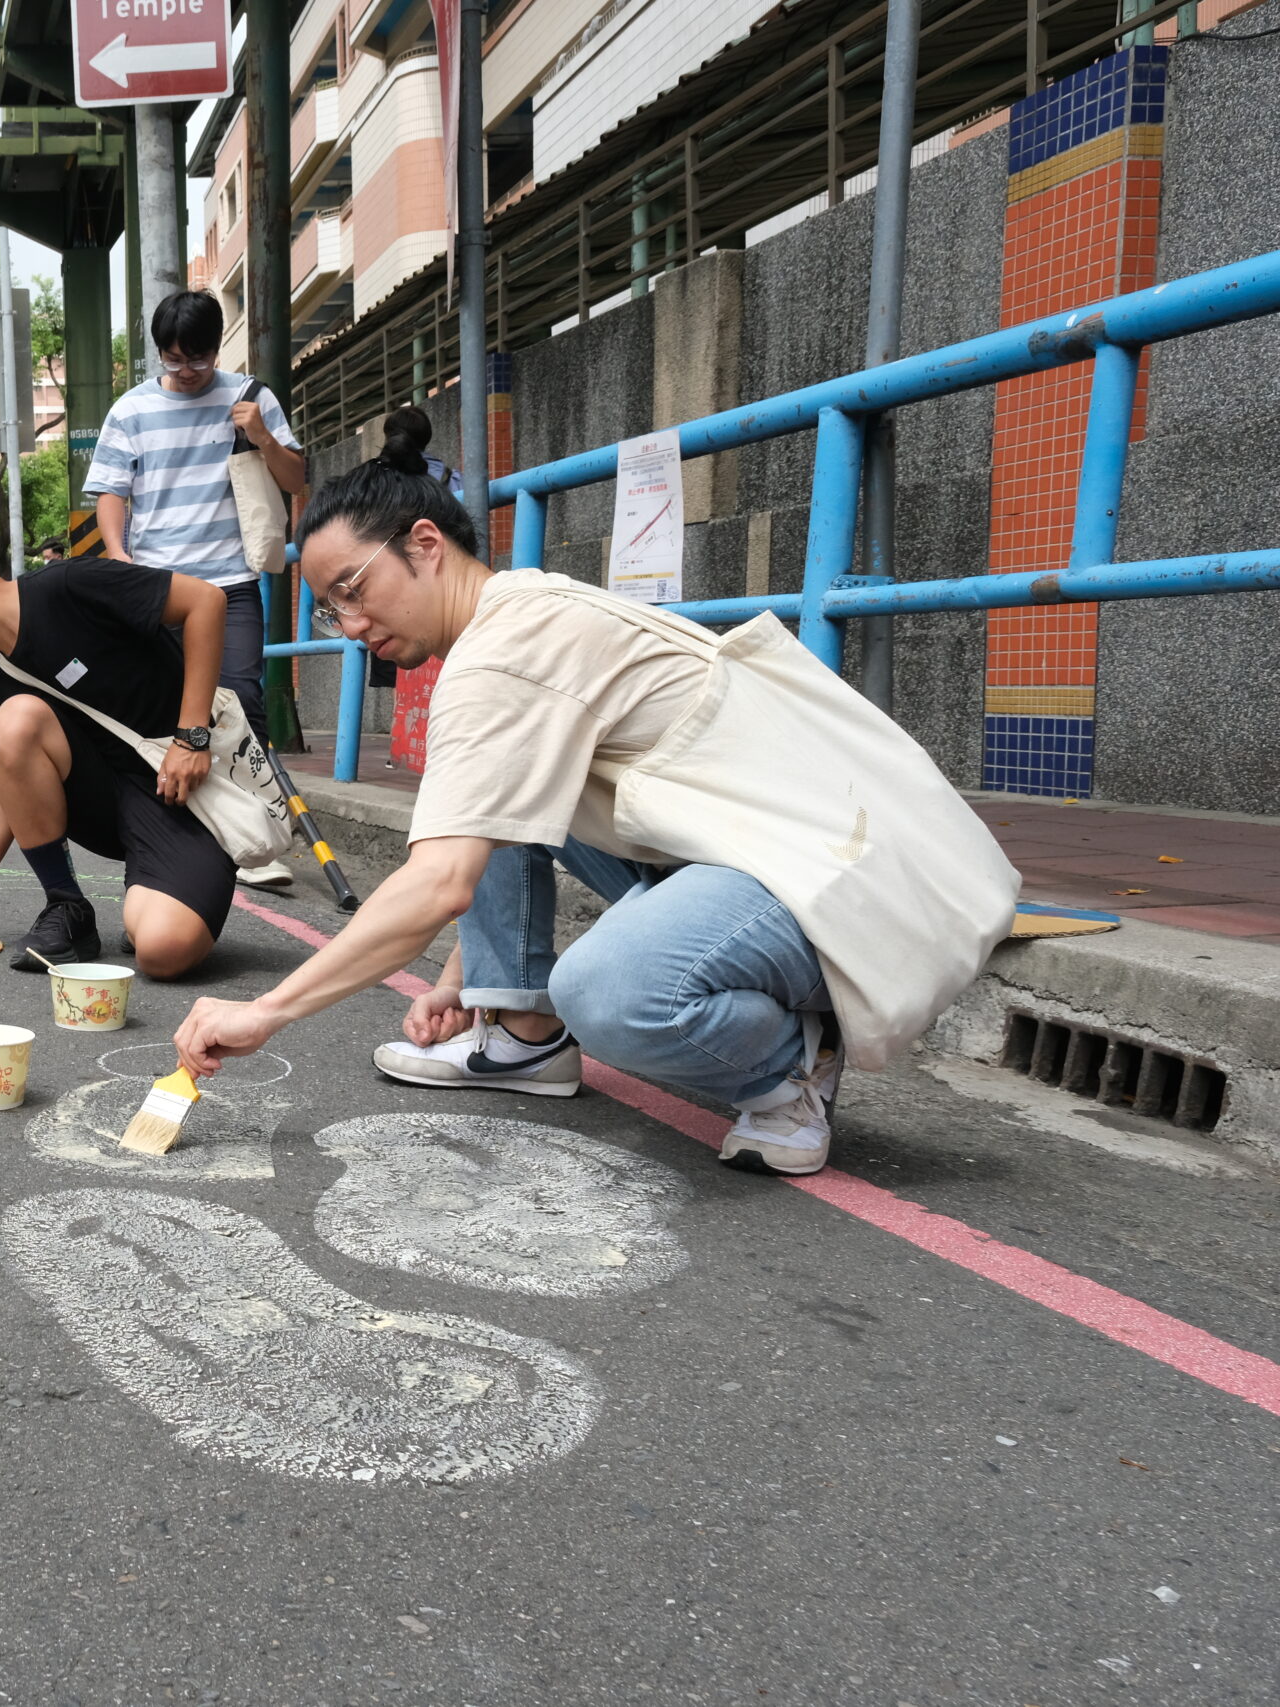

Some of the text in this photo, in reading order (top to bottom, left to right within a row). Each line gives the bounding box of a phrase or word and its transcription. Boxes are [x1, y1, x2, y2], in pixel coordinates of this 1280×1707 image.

[97, 0, 204, 21] Temple
[82, 986, 120, 1020] 事事如意
